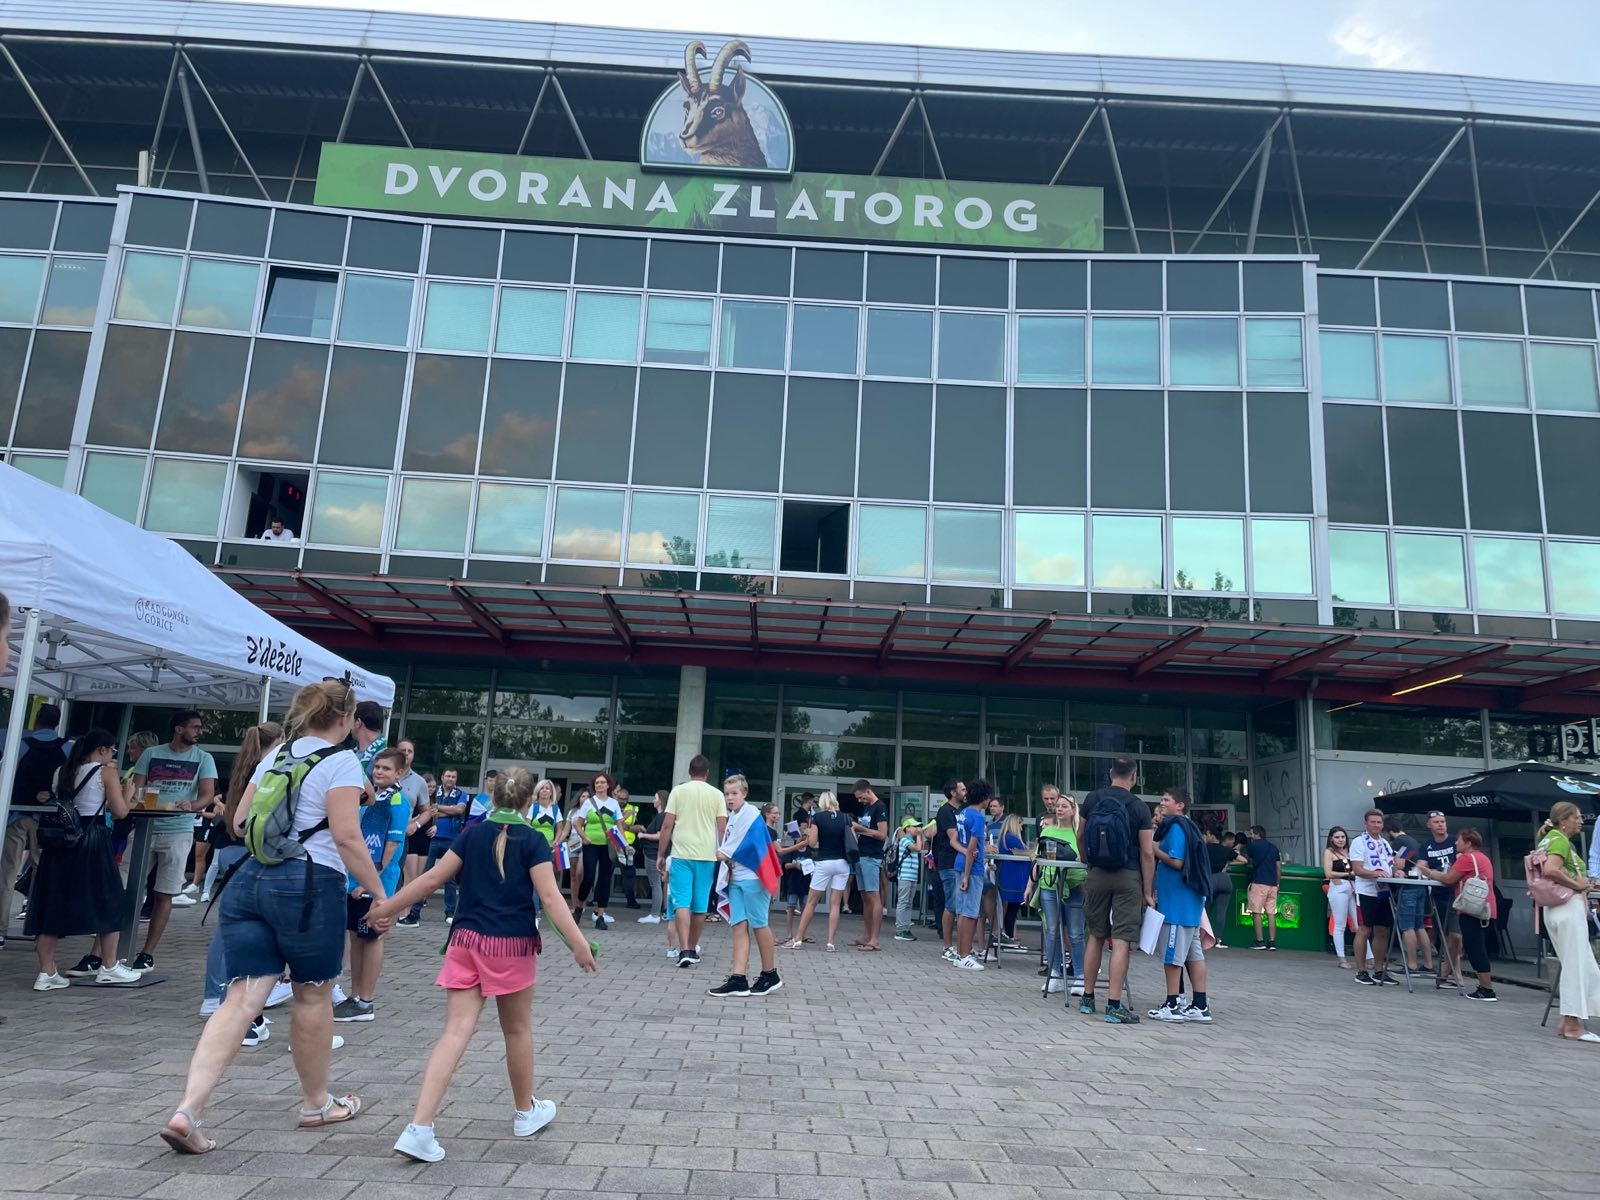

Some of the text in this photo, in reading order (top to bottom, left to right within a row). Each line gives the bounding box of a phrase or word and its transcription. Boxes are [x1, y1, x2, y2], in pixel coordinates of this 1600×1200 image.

[384, 163, 1037, 232] DVORANA ZLATOROG
[144, 613, 174, 632] GORICE
[145, 600, 190, 625] RADGONSKE
[531, 742, 568, 754] VHOD
